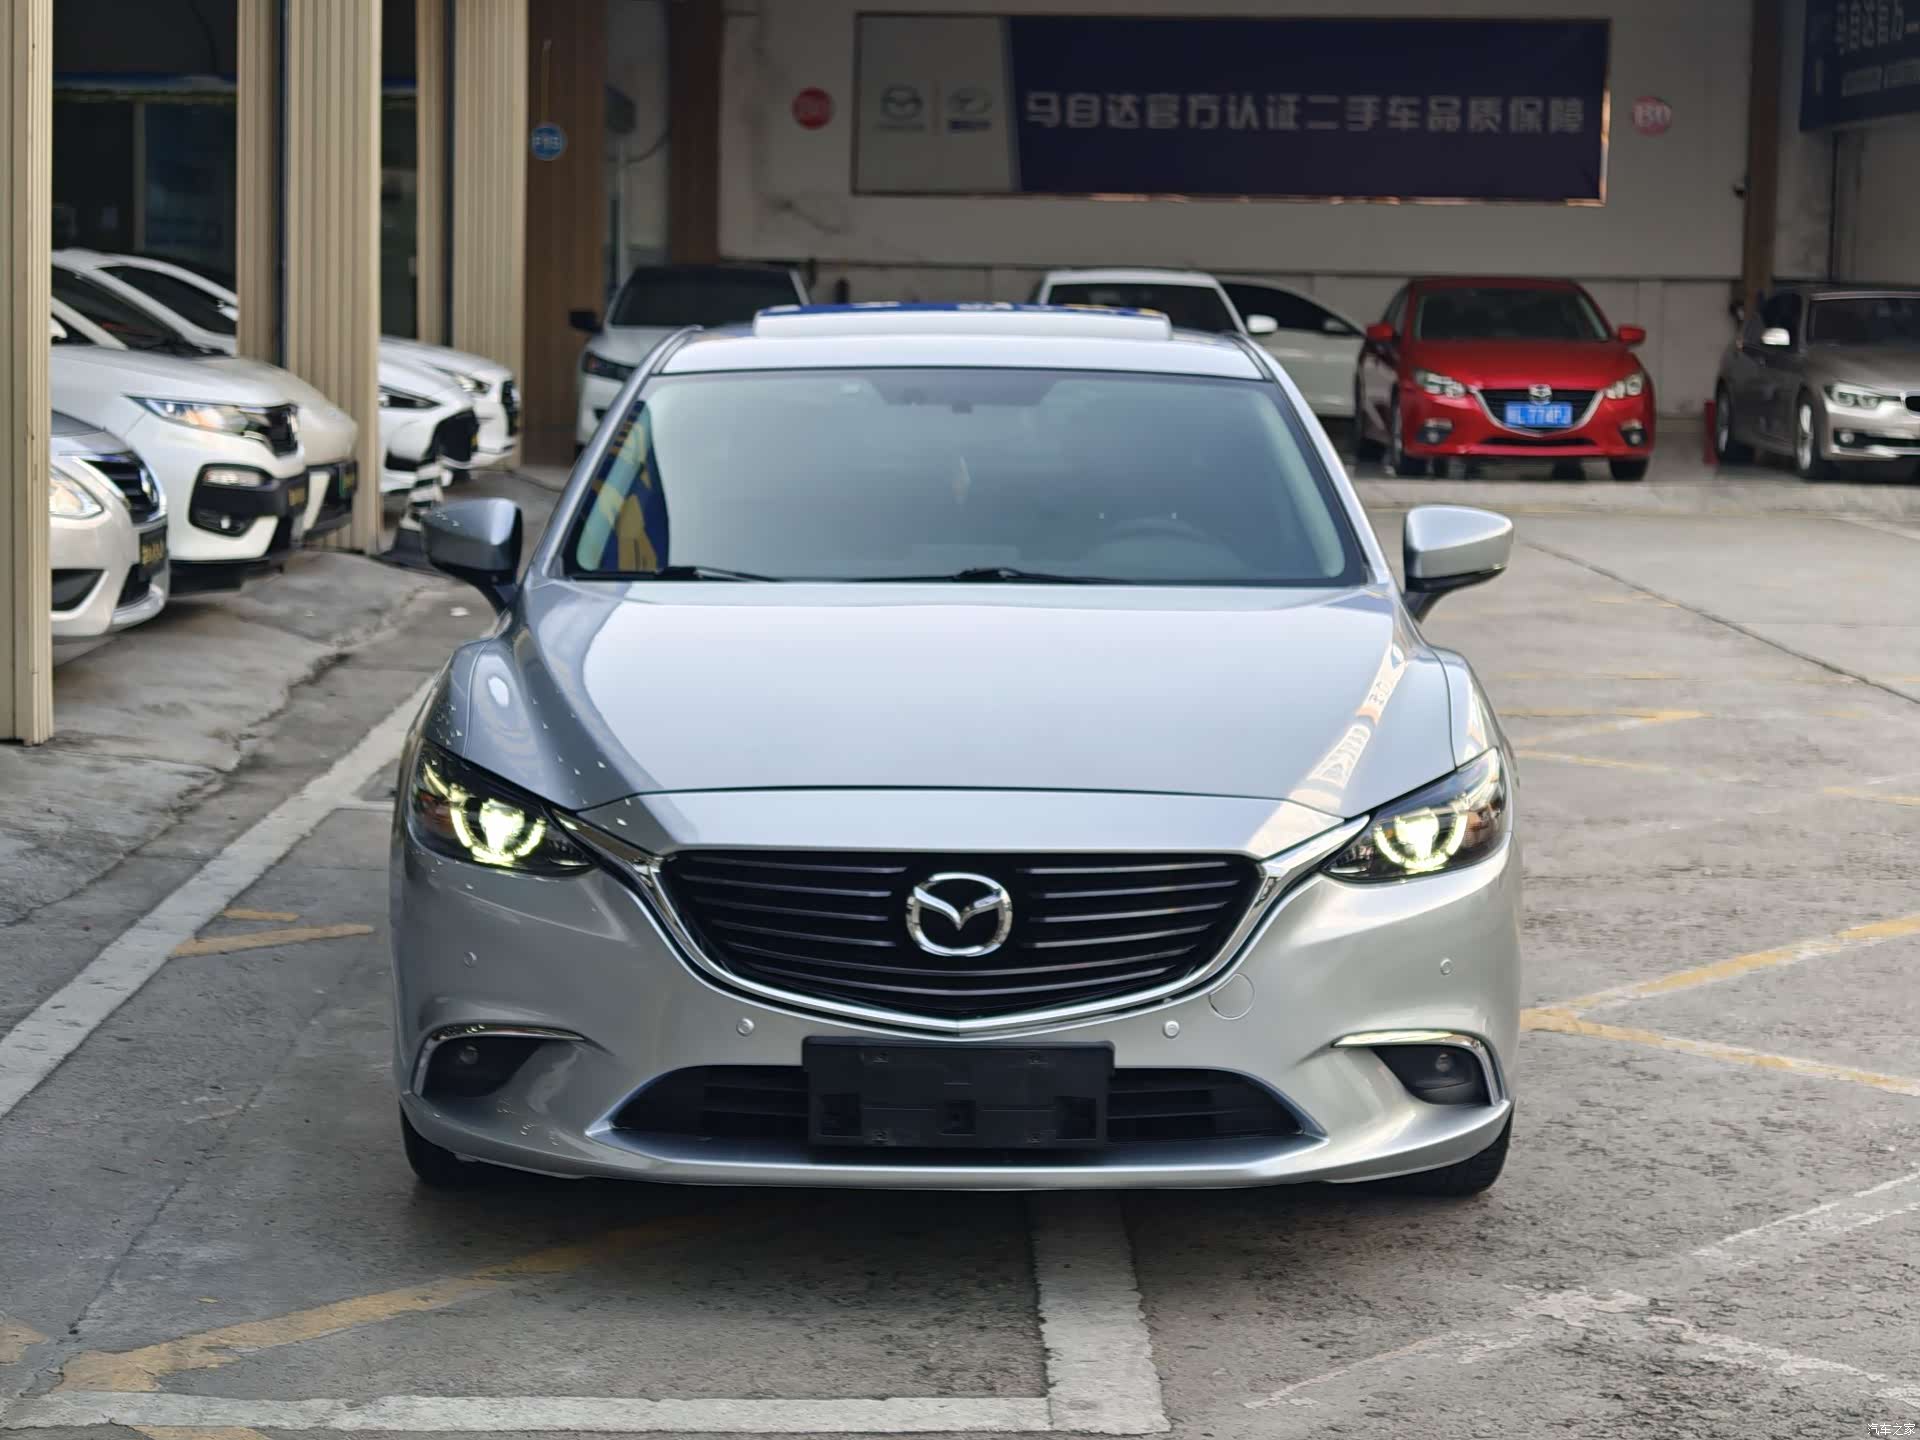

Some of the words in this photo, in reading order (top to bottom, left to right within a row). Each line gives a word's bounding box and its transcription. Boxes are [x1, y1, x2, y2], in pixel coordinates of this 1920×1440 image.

[1025, 90, 1585, 134] 马自达官方认证二手车品质保障
